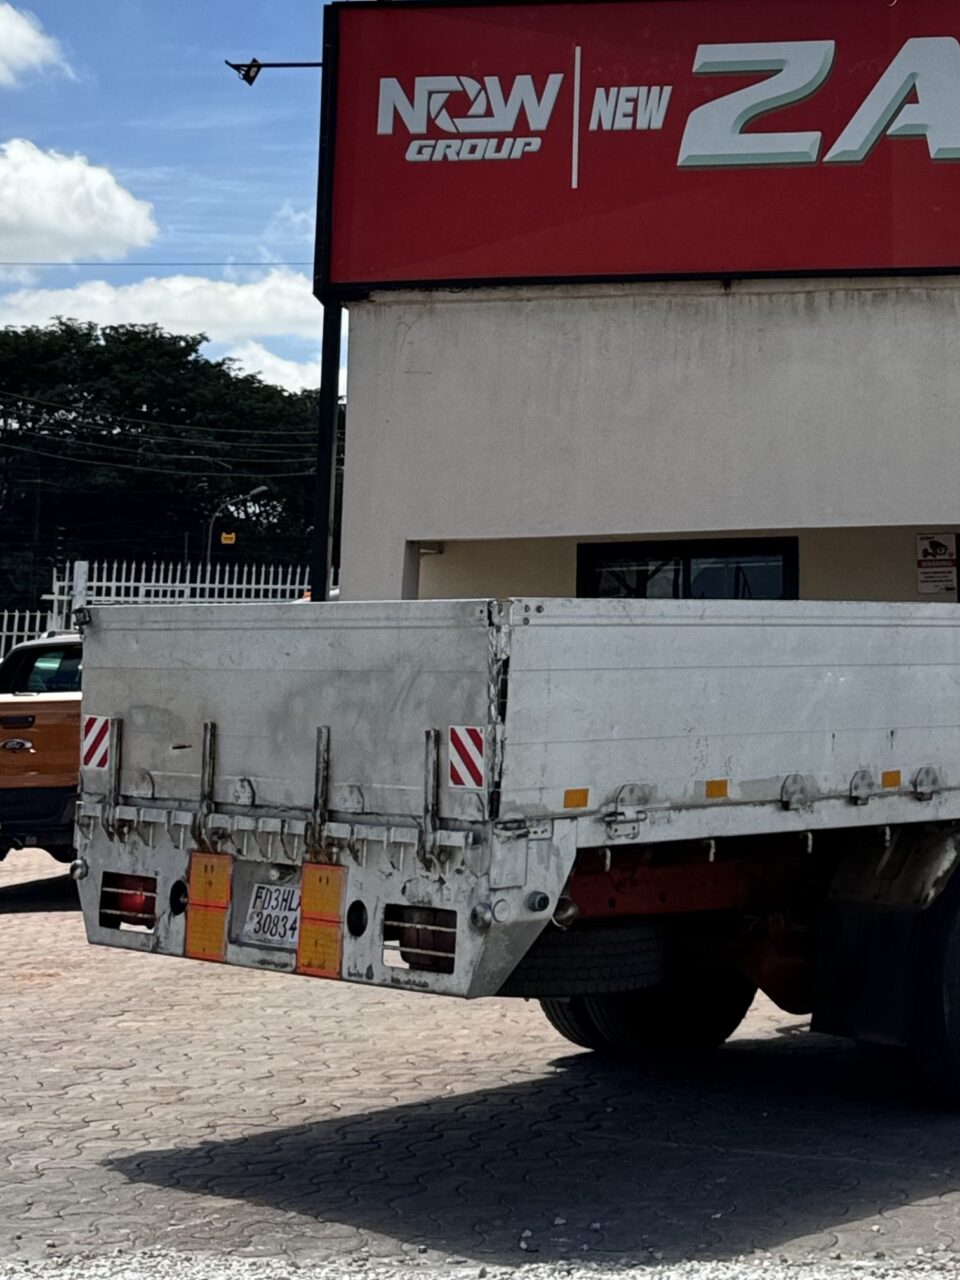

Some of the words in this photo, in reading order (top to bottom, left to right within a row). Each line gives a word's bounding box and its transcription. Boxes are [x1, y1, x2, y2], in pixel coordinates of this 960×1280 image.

[589, 86, 673, 131] NEW
[405, 136, 542, 162] GROUP
[253, 911, 298, 939] 30834
